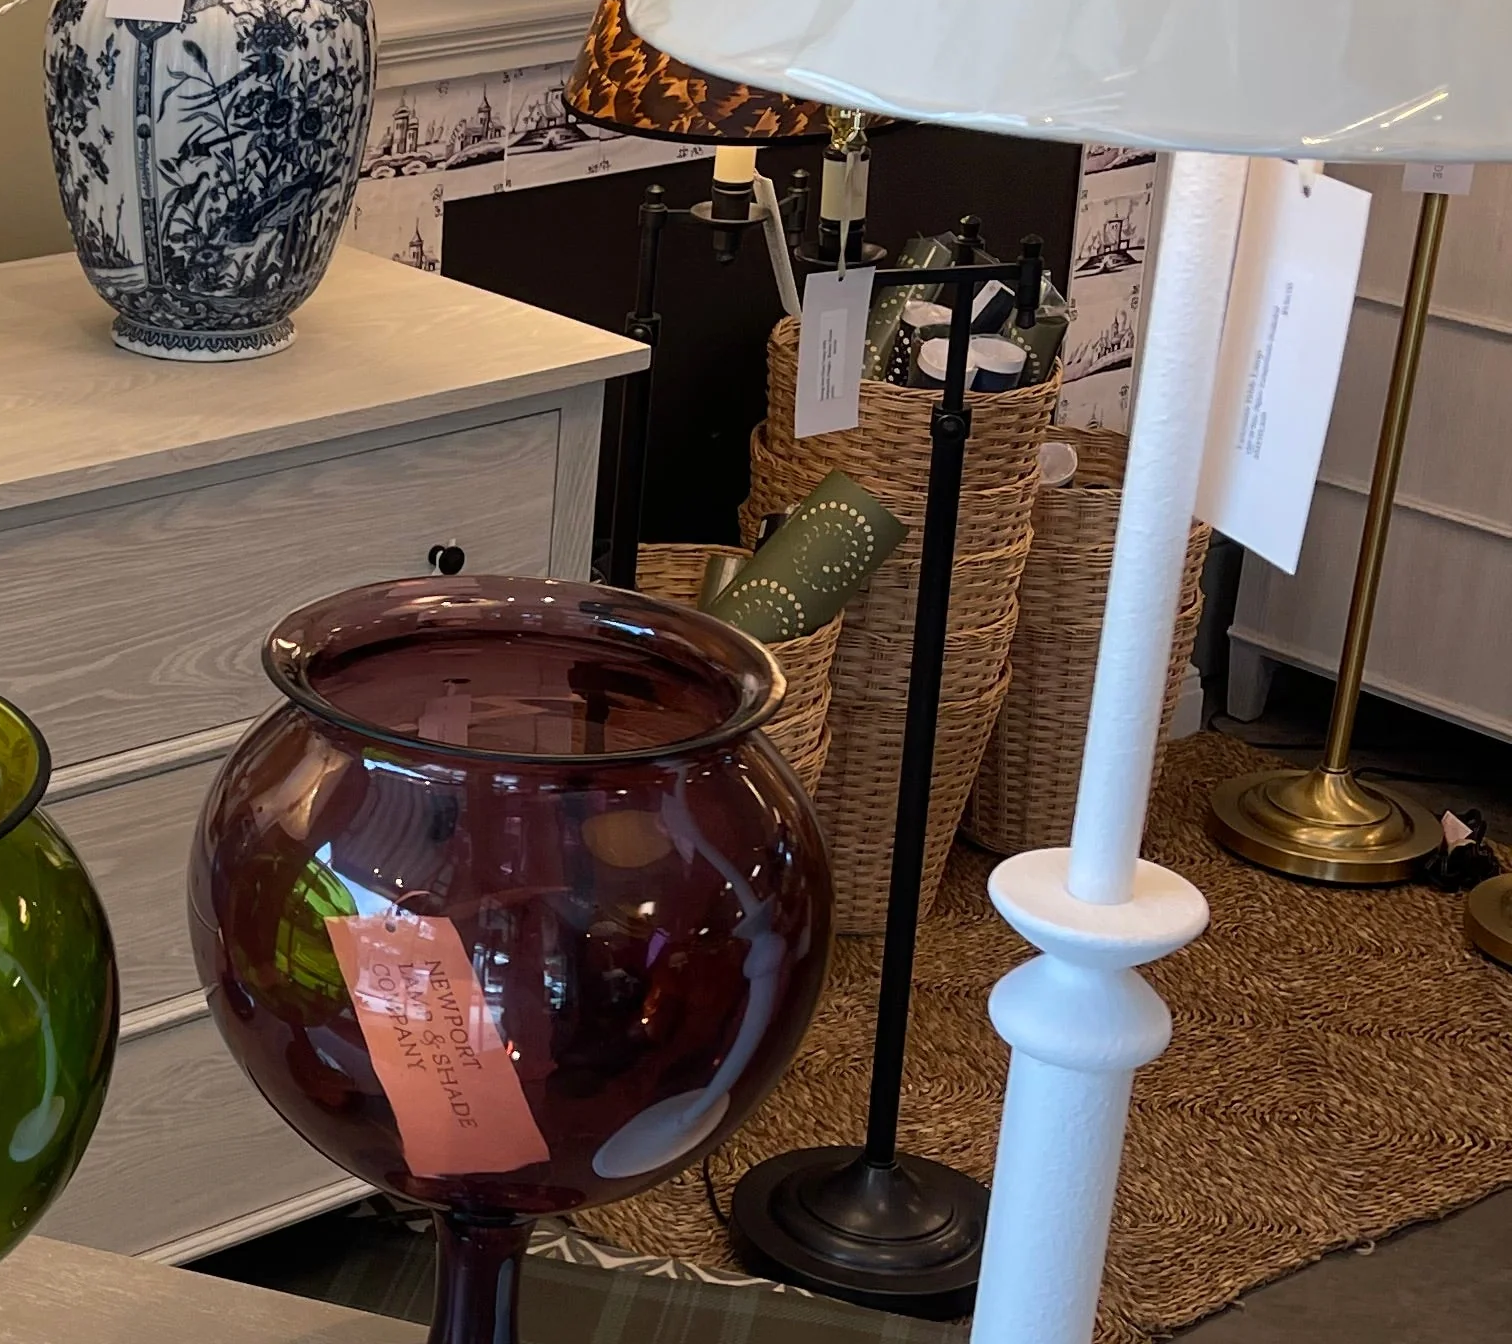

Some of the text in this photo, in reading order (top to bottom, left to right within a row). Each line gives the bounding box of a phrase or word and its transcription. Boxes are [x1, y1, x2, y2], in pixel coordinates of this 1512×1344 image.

[420, 1030, 446, 1049] &
[425, 960, 483, 1070] NEWPORT
[432, 1054, 478, 1129] SHADE
